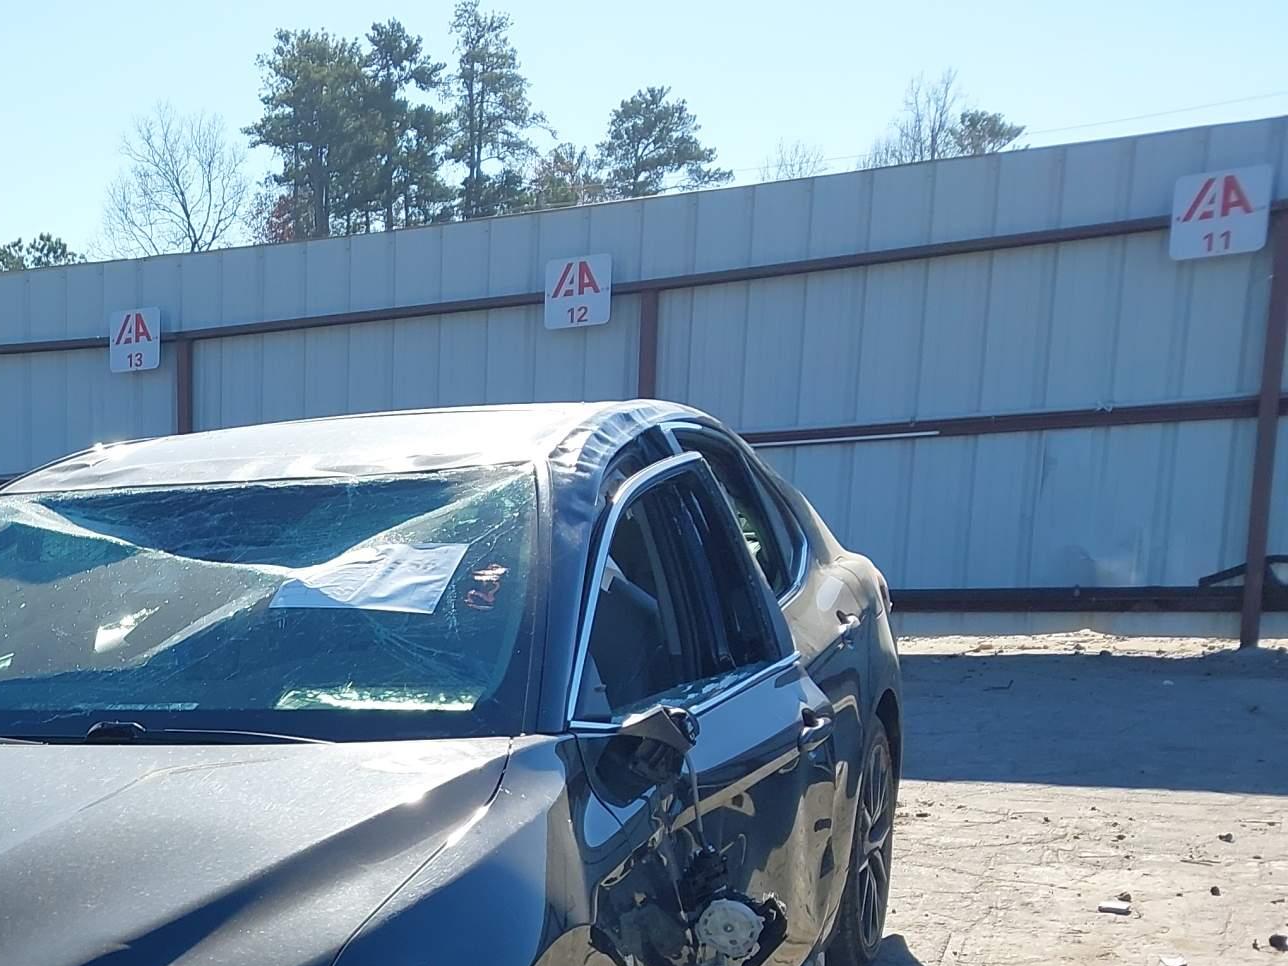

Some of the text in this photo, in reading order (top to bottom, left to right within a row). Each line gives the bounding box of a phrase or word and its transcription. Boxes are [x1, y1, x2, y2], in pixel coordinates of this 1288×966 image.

[1203, 230, 1232, 252] 11
[567, 306, 588, 323] 12
[127, 352, 143, 369] 13
